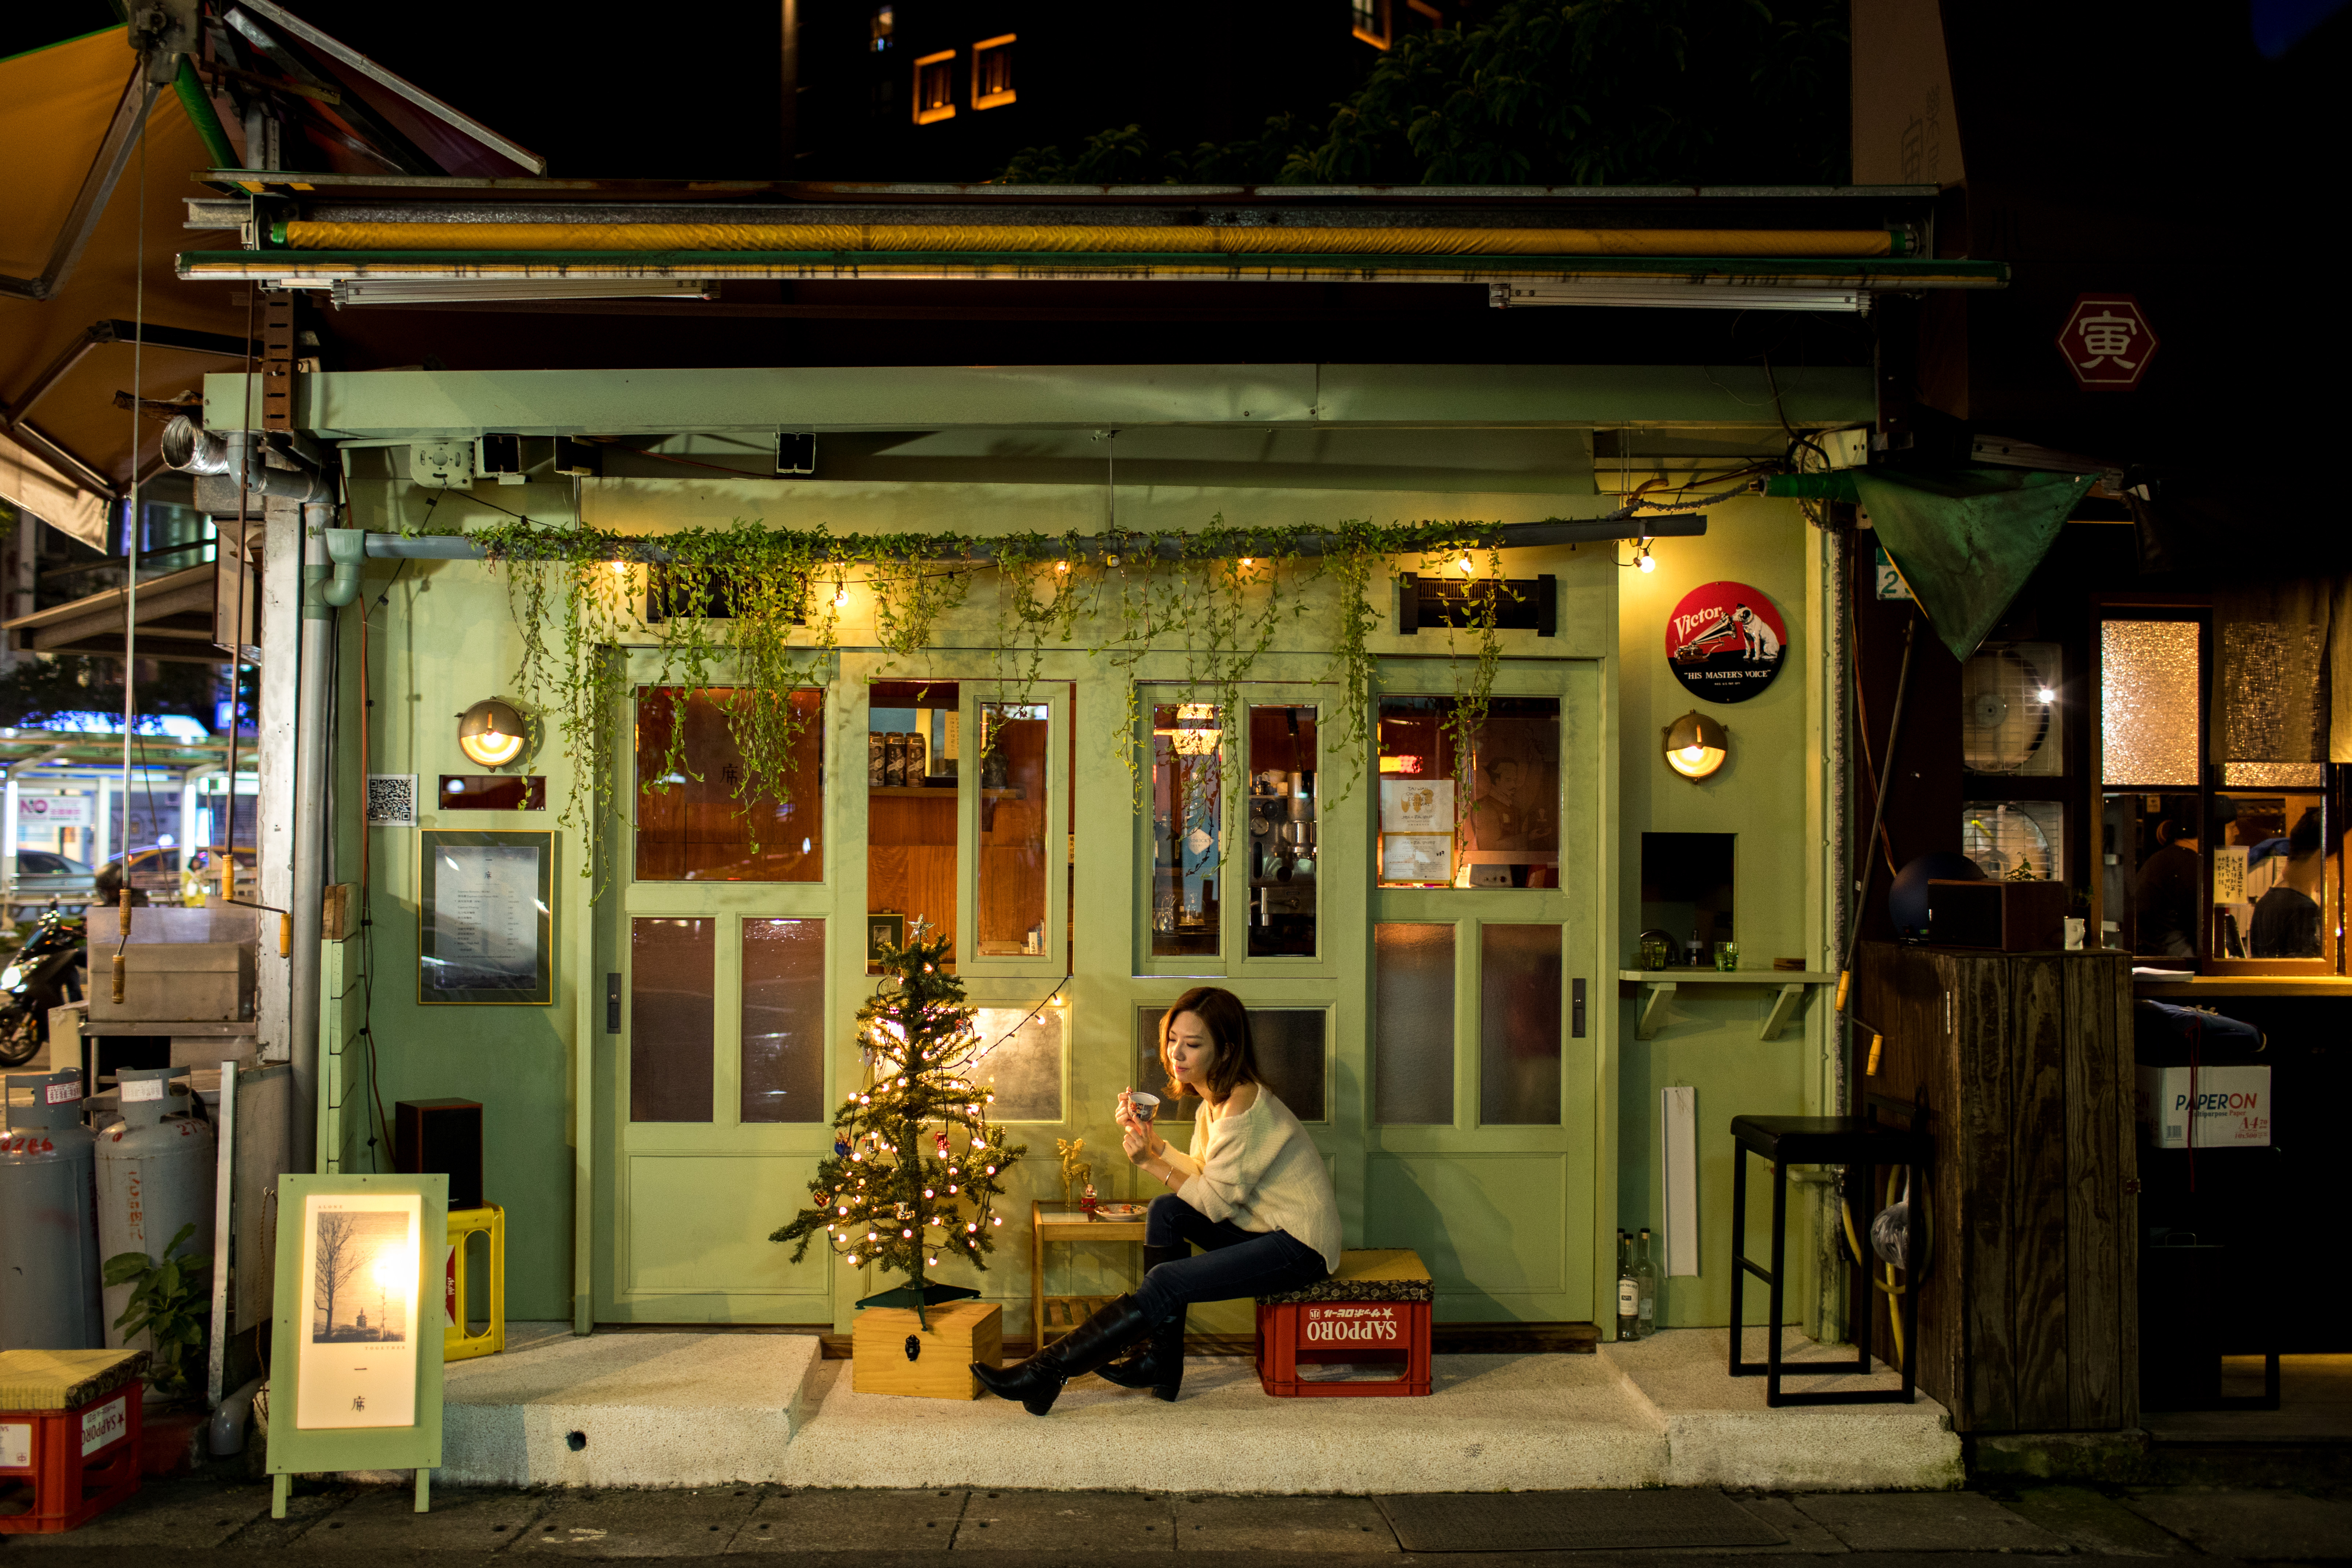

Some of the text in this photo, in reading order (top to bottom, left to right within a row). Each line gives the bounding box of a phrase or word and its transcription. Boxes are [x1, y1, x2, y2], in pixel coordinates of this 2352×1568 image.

[2078, 310, 2137, 369] 寅
[1673, 606, 1723, 643] Victor
[2238, 1116, 2259, 1129] A4
[1307, 1320, 1397, 1341] SAPPORO
